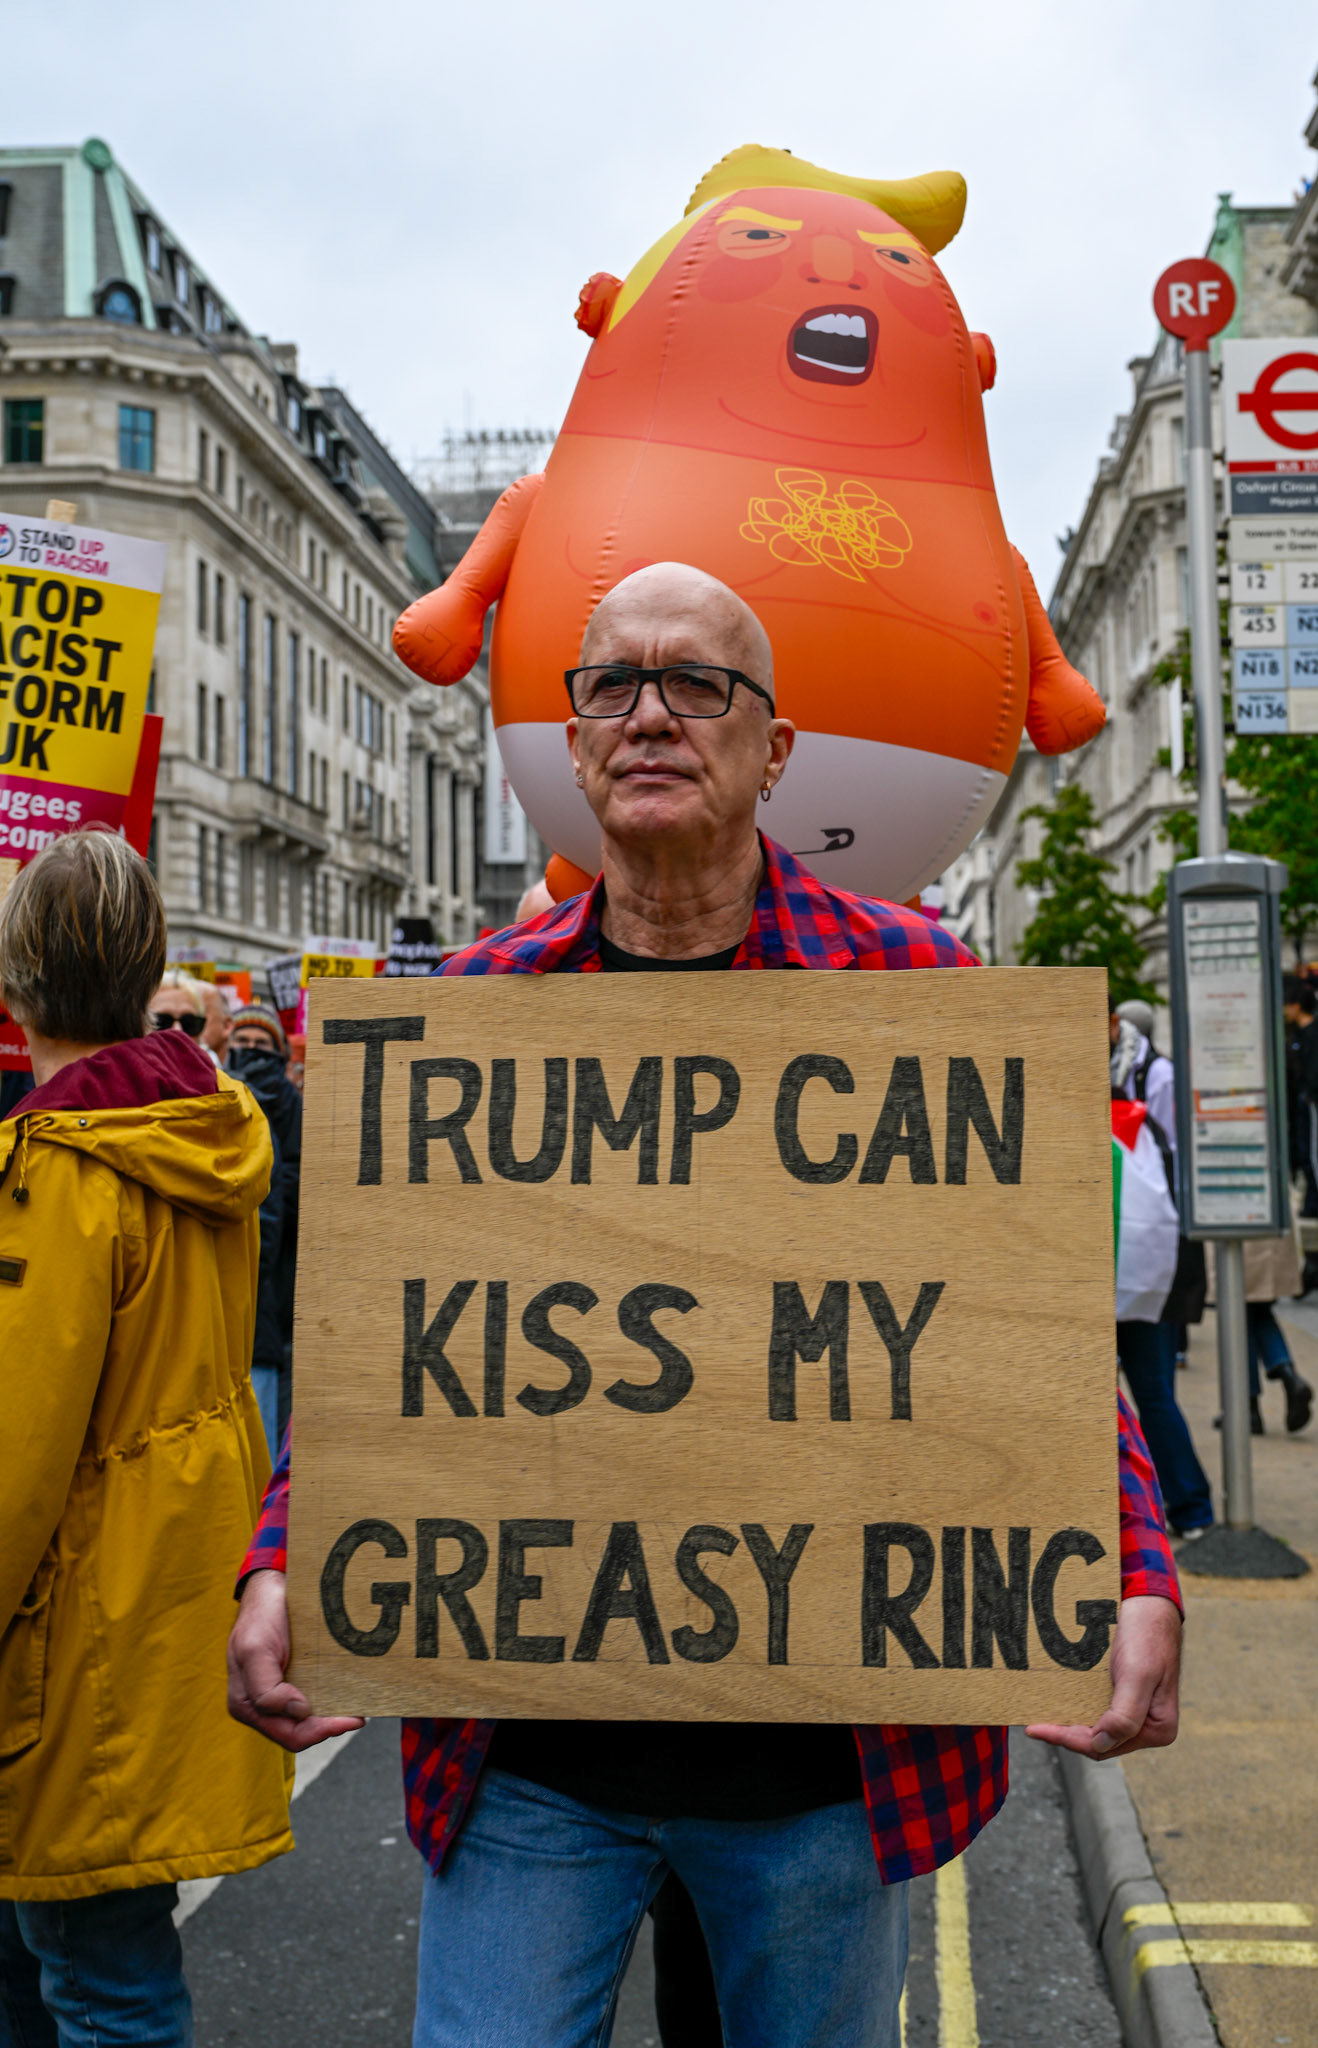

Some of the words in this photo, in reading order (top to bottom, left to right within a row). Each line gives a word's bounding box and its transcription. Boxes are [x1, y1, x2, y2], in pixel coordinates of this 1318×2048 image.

[1168, 280, 1221, 318] RF
[1235, 481, 1279, 495] Oxford
[20, 528, 76, 551] STAND
[79, 539, 105, 556] UP
[19, 546, 41, 563] TO
[44, 549, 110, 577] RACISM
[1246, 573, 1267, 590] 12
[0, 573, 104, 628] TOP
[1243, 617, 1277, 633] 453
[1241, 660, 1280, 677] N18
[1237, 703, 1288, 720] N136
[774, 1053, 1025, 1186] CAN
[400, 1278, 700, 1419] KISS
[767, 1279, 946, 1422] MY
[320, 1517, 815, 1665] GREASY
[861, 1521, 1118, 1671] RING
